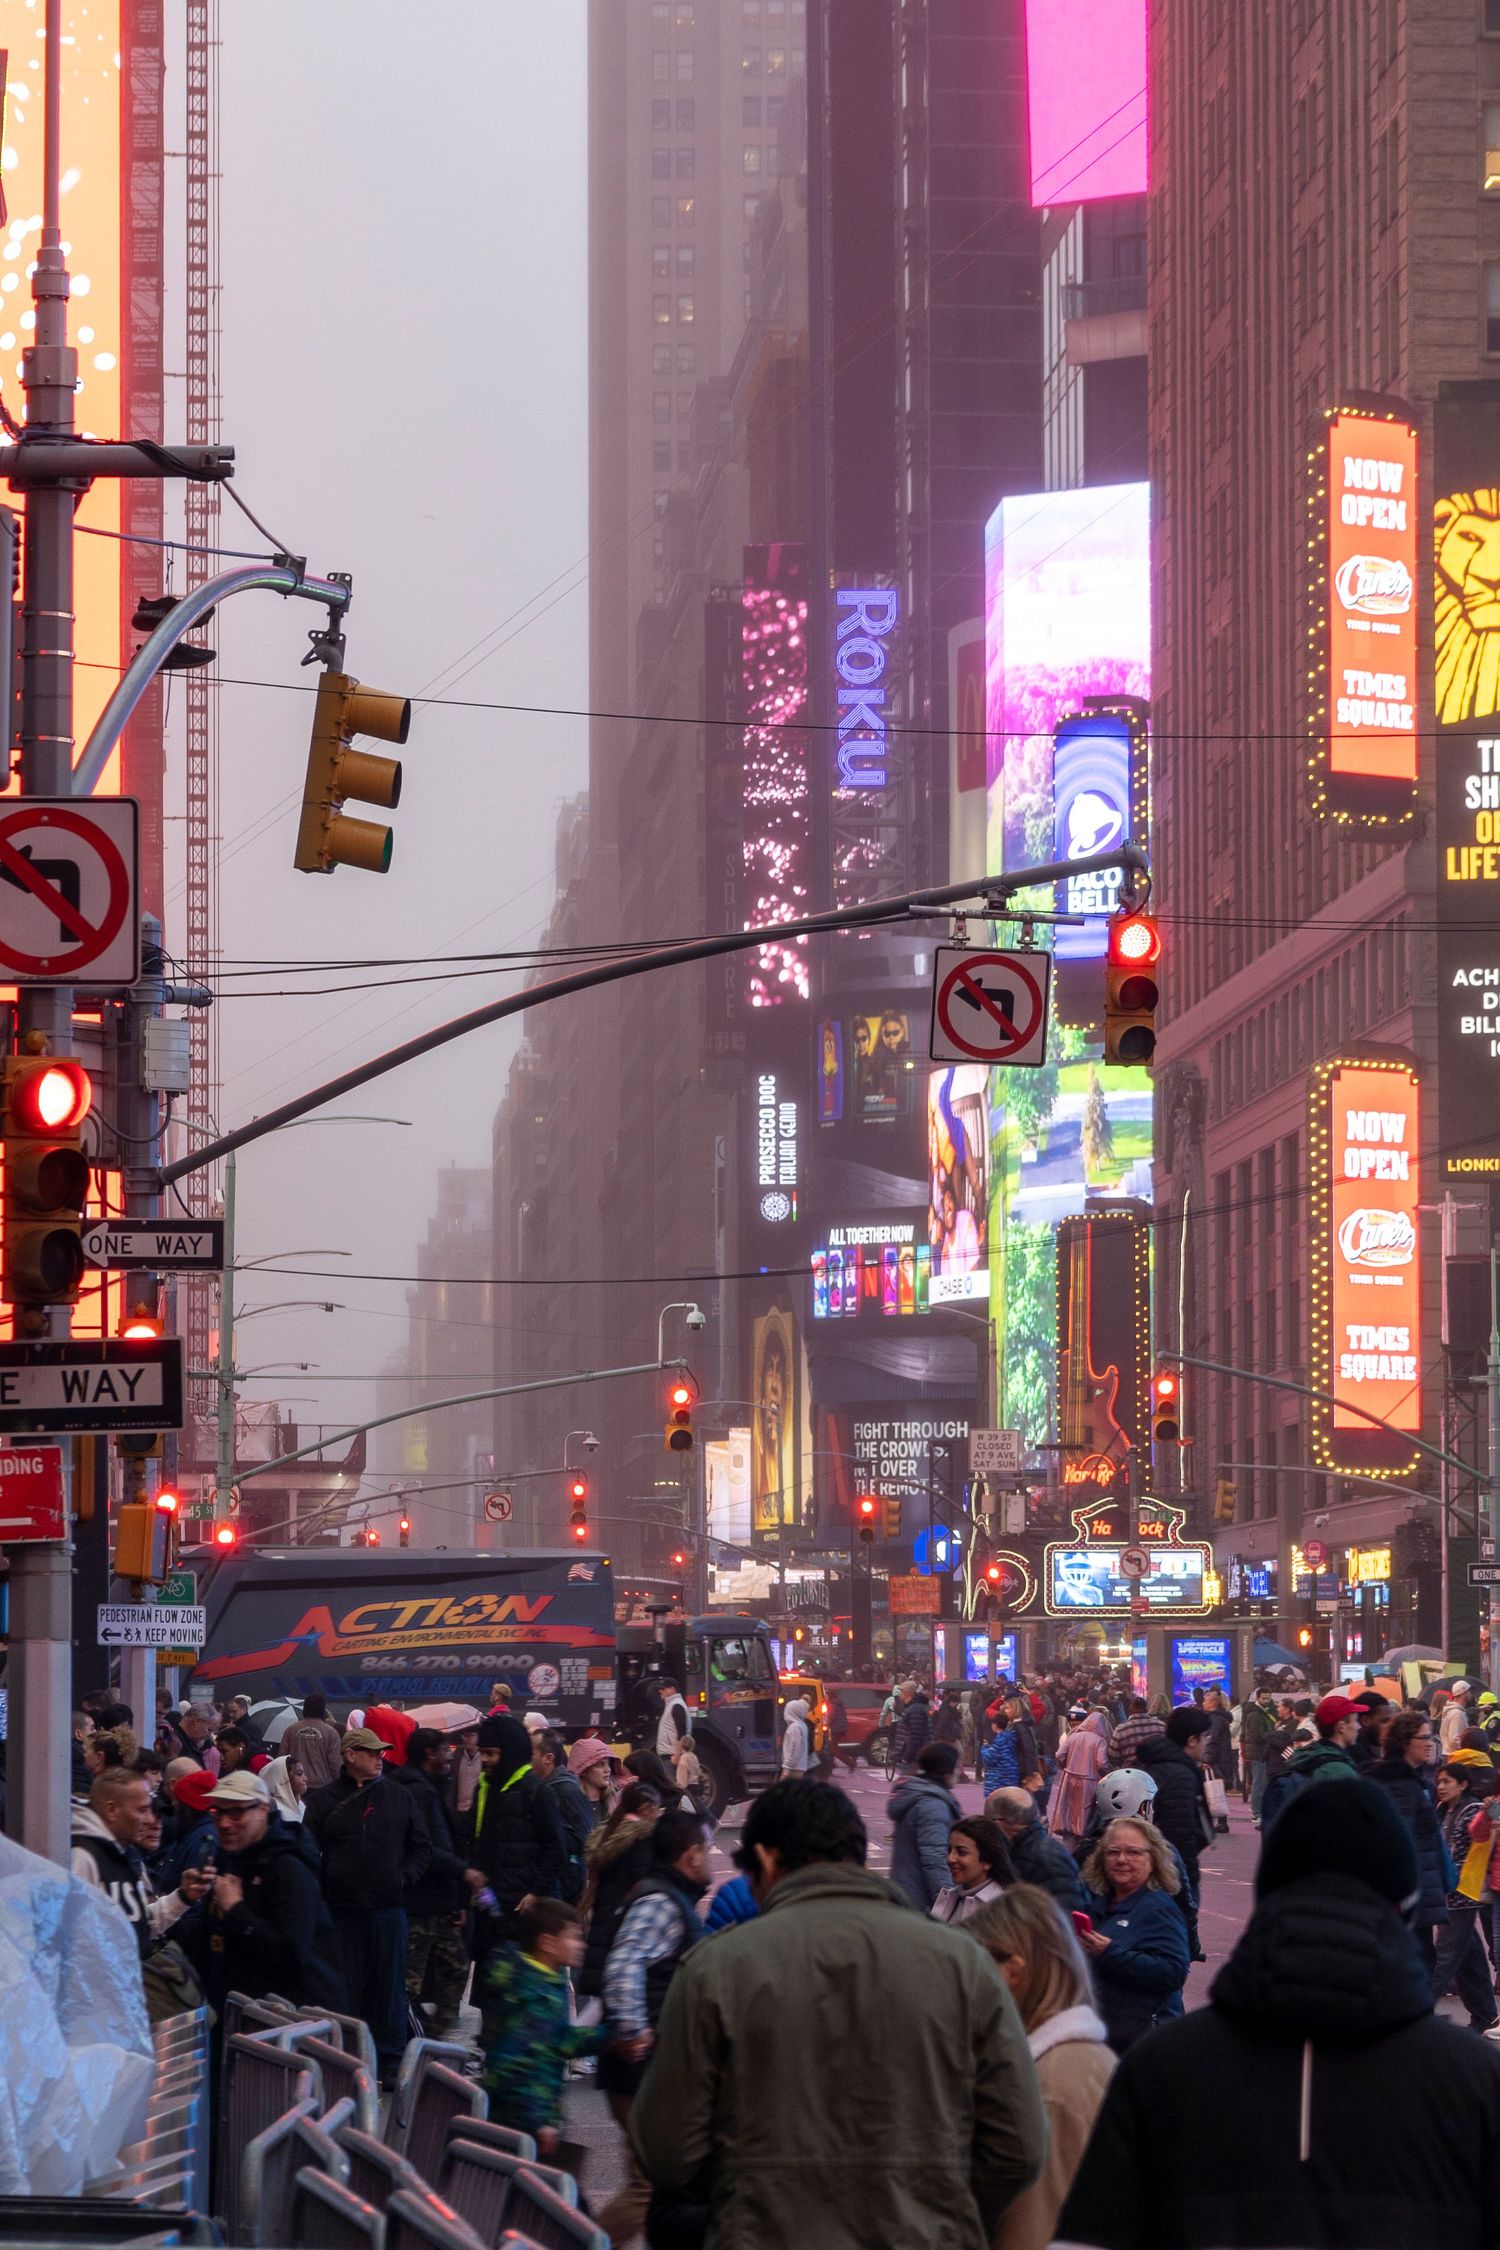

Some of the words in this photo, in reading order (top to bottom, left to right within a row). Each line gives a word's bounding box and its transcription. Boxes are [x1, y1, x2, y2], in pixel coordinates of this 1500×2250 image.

[1344, 456, 1404, 494] NOW
[1341, 494, 1407, 531] OPEN
[1343, 669, 1406, 700] TIMES
[1337, 697, 1413, 730] SQUARE
[1465, 775, 1500, 809] SH
[1447, 847, 1500, 880] LIFE
[1068, 889, 1121, 914] BELL
[759, 1075, 776, 1105] DOC
[779, 1102, 797, 1138] GENIO
[1346, 1110, 1406, 1144] NOW
[759, 1108, 776, 1185] PROSECCO
[779, 1140, 797, 1185] ITALIAN
[1344, 1147, 1409, 1181] OPEN
[89, 1235, 133, 1254] ONE
[156, 1235, 203, 1255] WAY
[829, 1228, 847, 1245] ALL
[846, 1226, 891, 1245] TOGETHER
[891, 1225, 914, 1242] NOW
[1346, 1325, 1409, 1352] TIMES
[1340, 1354, 1416, 1382] SQUARE
[61, 1368, 146, 1404] WAY
[854, 1423, 890, 1440] FIGHT
[892, 1421, 968, 1439] THROUGH
[855, 1441, 877, 1458] THE
[977, 1442, 1012, 1450] CLOSED
[854, 1460, 878, 1477] NT
[881, 1460, 917, 1477] OVER
[1478, 1570, 1496, 1579] ONE
[101, 1608, 152, 1623] PEDESTRIAN
[155, 1609, 178, 1623] FLOW
[181, 1610, 203, 1624] ZONE
[286, 1594, 556, 1657] ACTION
[145, 1628, 167, 1642] KEEP
[170, 1629, 203, 1643] MOVING
[333, 1636, 386, 1651] CARTING
[390, 1629, 493, 1646] ENVIRONMENTAL
